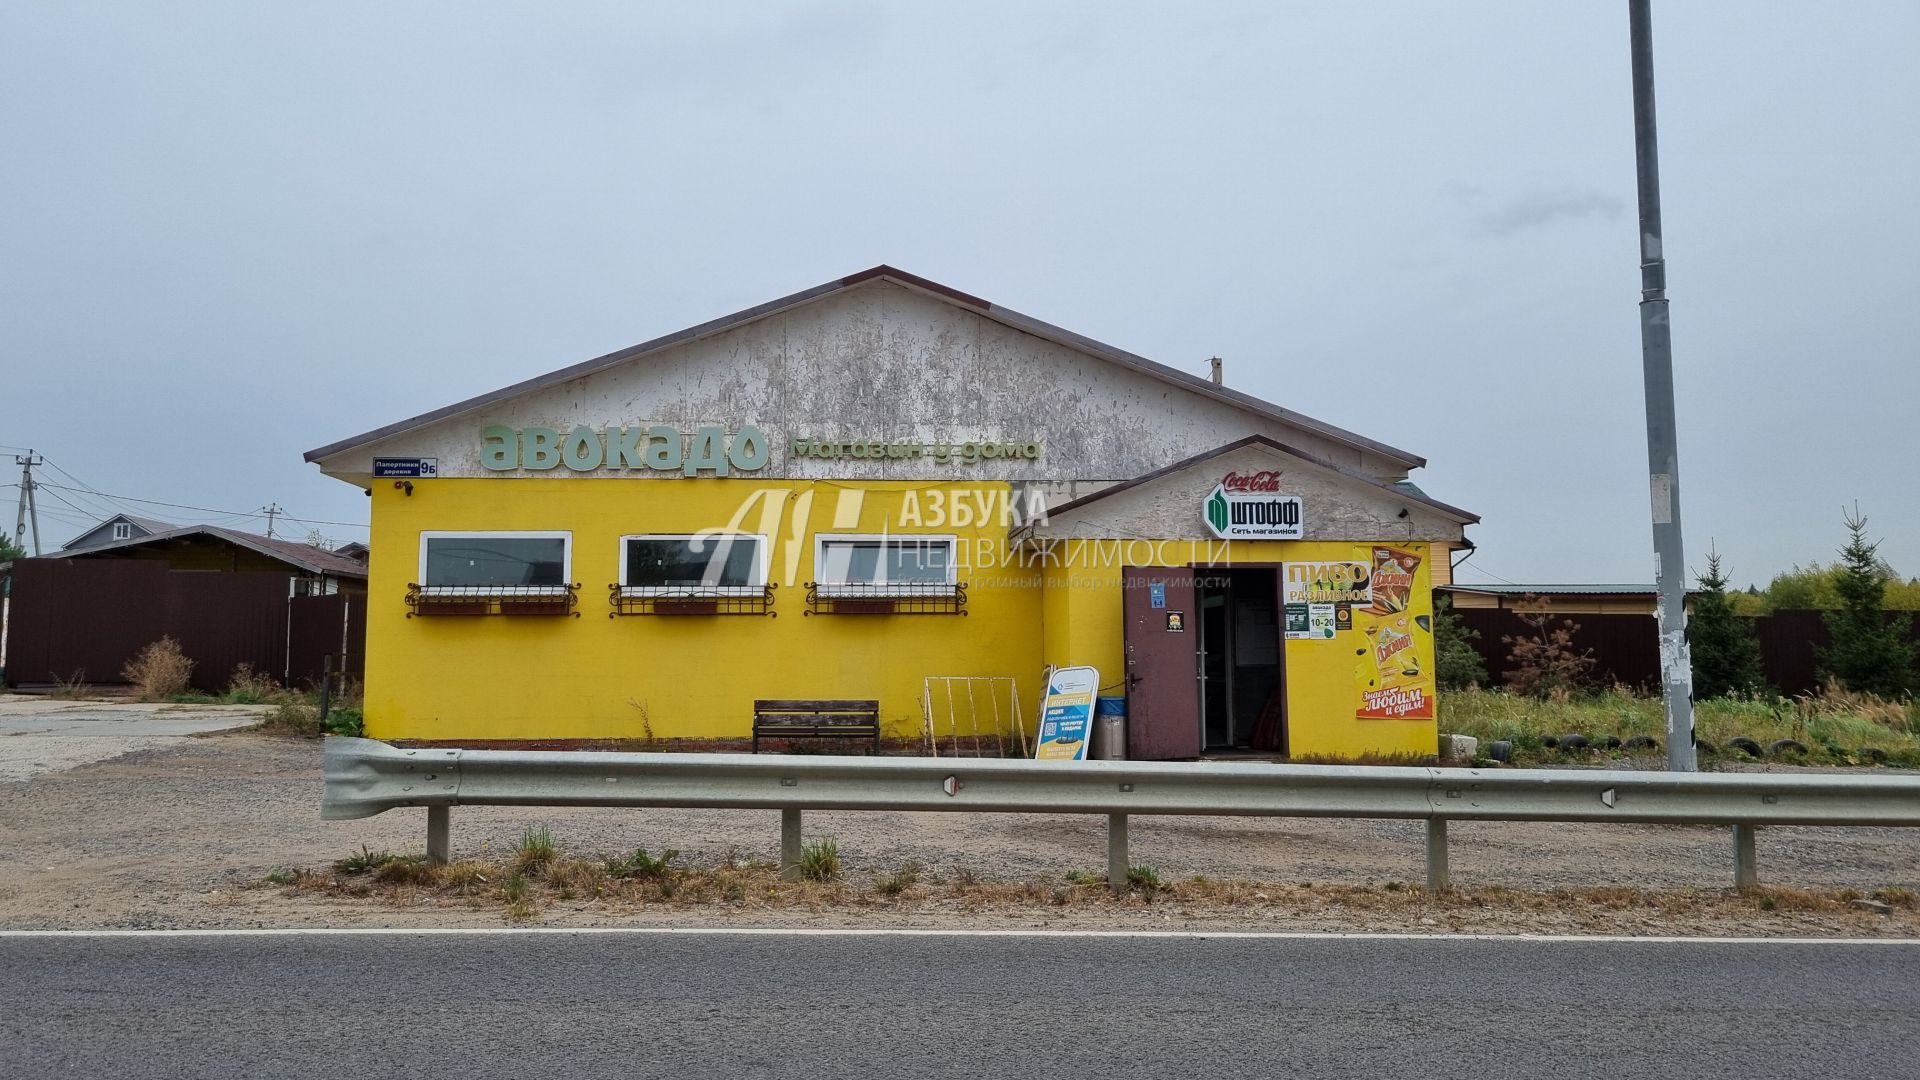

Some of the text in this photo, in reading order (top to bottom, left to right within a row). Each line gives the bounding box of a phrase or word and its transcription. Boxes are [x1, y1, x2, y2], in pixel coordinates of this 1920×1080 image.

[480, 425, 769, 477] авокадо
[790, 438, 1041, 464] Магазин у дома
[376, 461, 419, 469] Папертники
[1288, 564, 1368, 583] ПИВО
[1289, 589, 1368, 601] РАЗЛИВНОЕ
[1366, 687, 1421, 711] любим
[1386, 697, 1424, 716] и едим!
